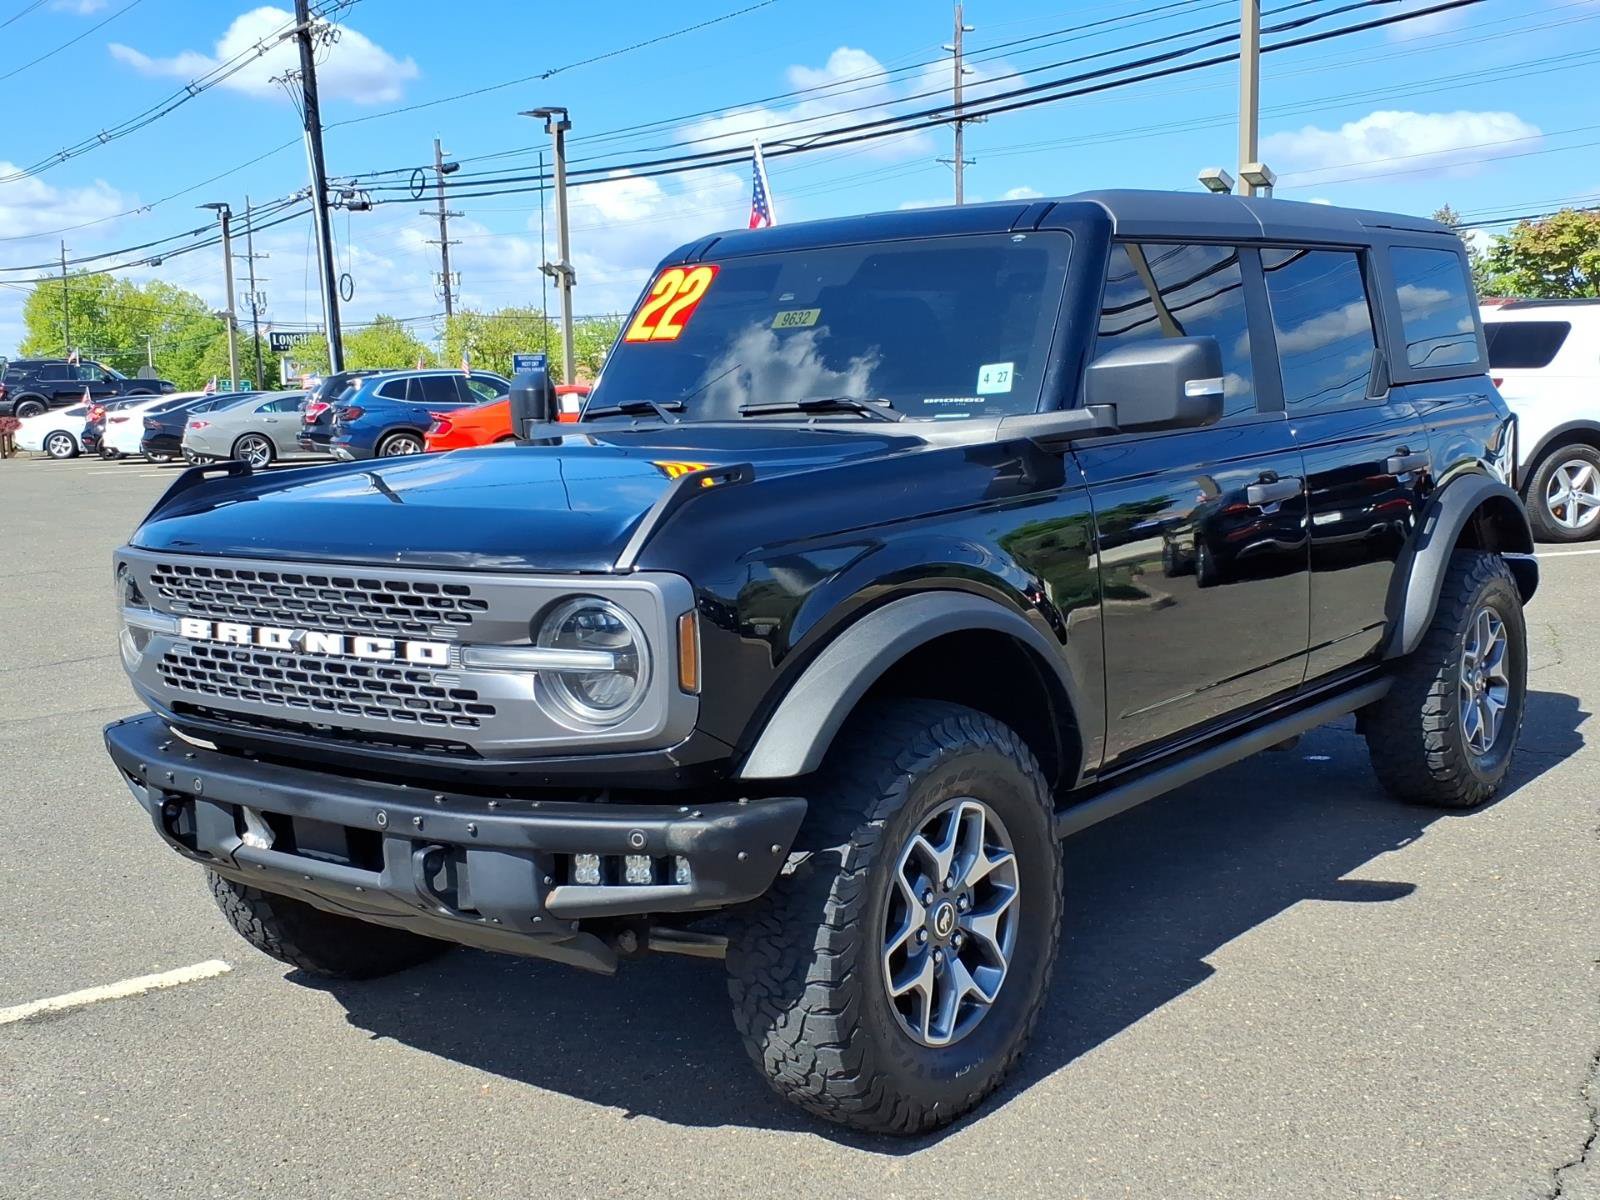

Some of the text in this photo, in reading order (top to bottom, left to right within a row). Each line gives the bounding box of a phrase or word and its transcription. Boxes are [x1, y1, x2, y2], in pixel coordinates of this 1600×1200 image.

[626, 266, 713, 340] 22
[781, 311, 811, 326] 9632
[983, 371, 1009, 384] 4 27
[179, 617, 451, 665] BRONCO
